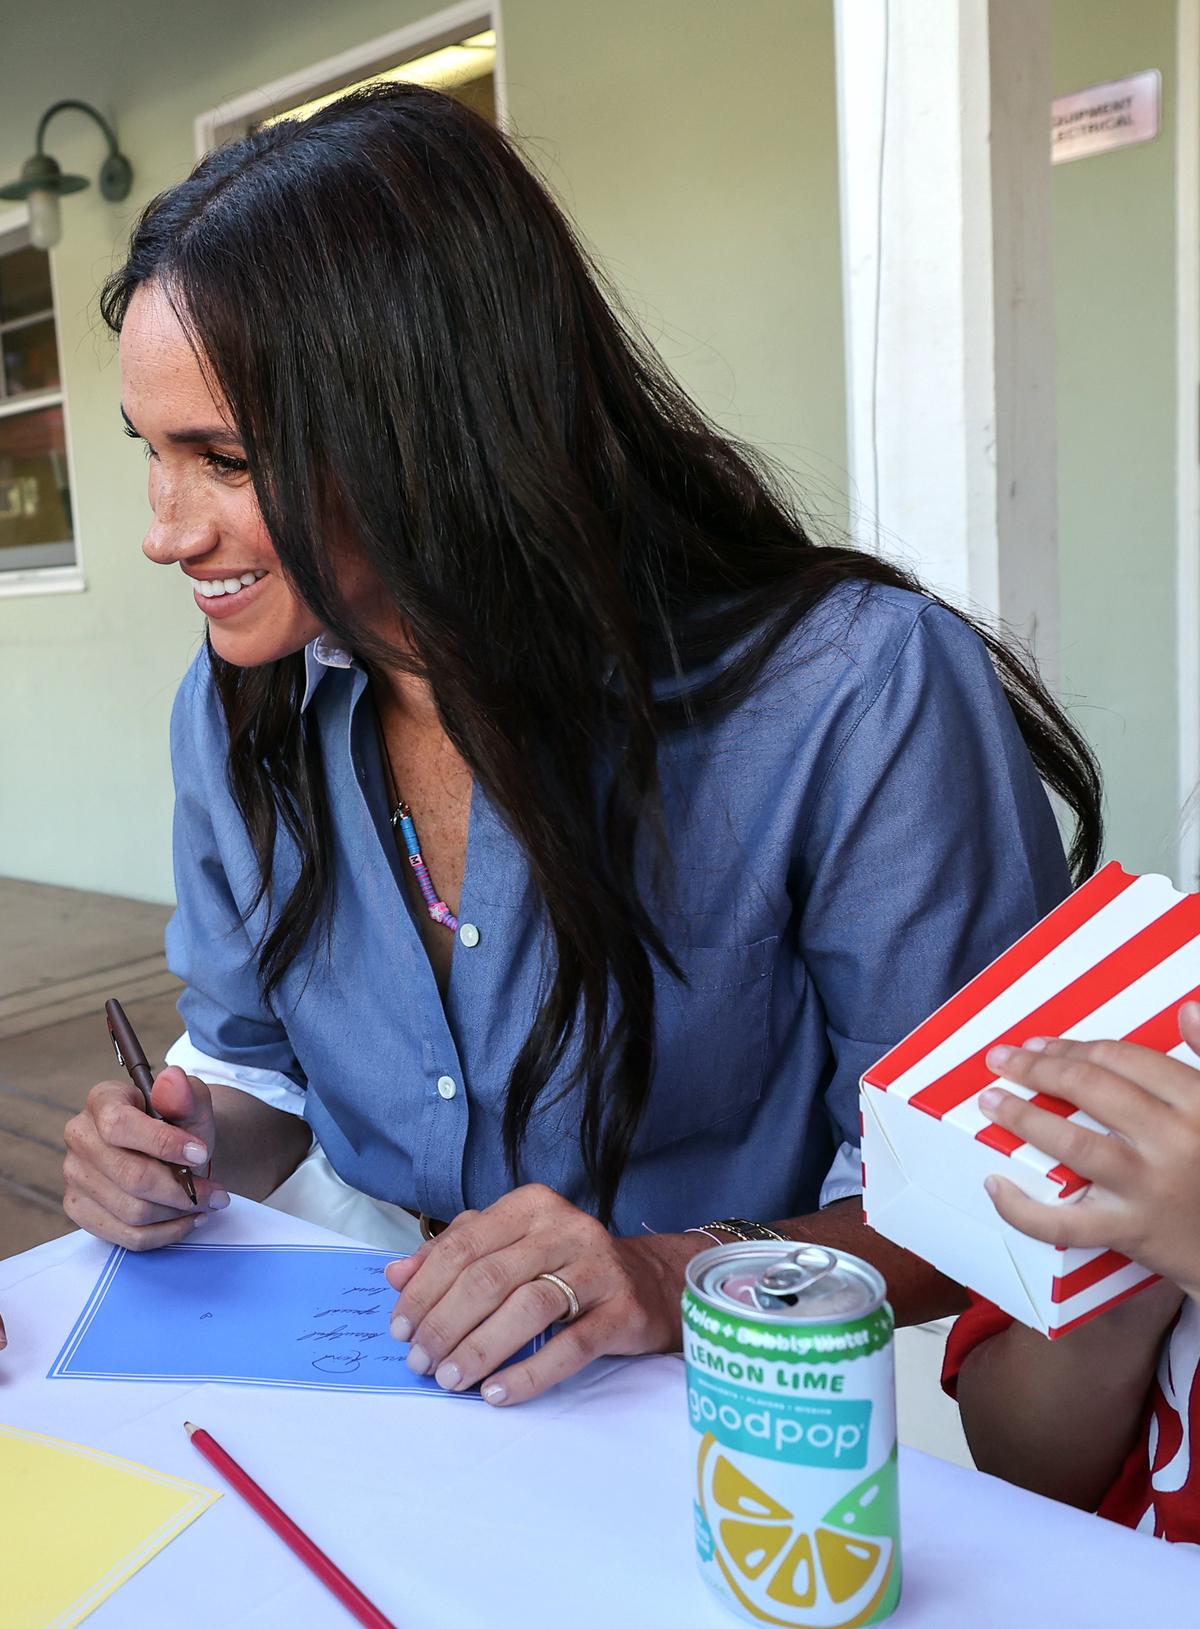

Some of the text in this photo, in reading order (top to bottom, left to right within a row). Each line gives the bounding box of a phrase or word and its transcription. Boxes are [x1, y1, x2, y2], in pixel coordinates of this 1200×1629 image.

[689, 1343, 765, 1384] LEMON
[776, 1368, 846, 1393] LIME
[688, 1386, 861, 1458] goodpop
